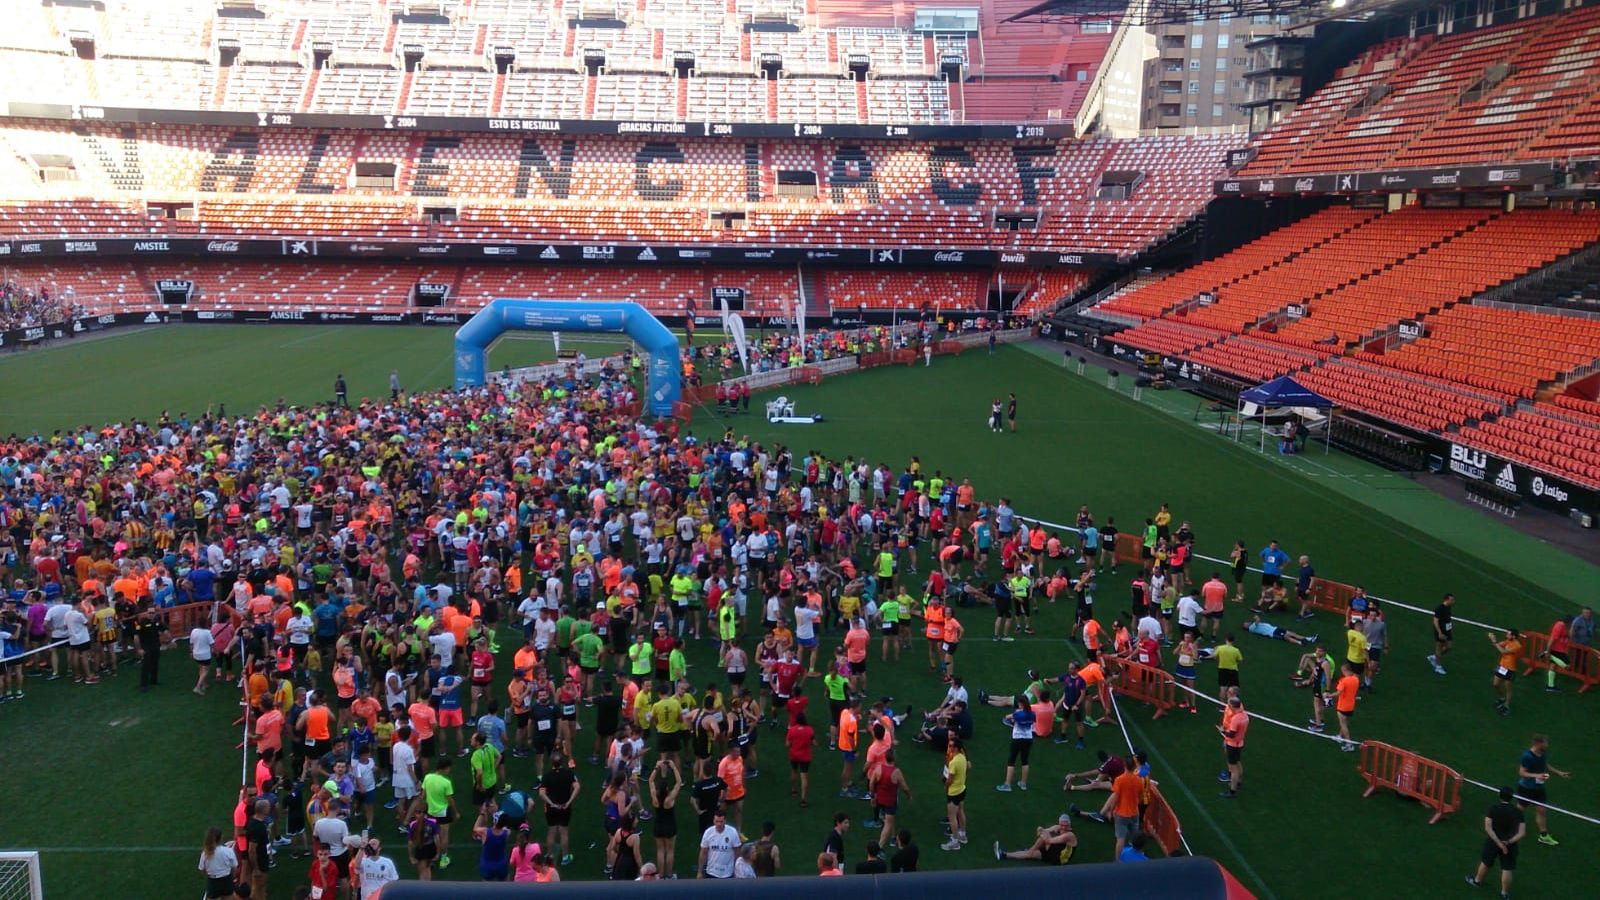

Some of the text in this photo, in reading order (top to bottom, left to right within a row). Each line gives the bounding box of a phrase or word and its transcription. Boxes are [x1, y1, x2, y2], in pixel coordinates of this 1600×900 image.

[489, 119, 560, 131] ESTO ES MESTALLA
[713, 124, 732, 134] 2004
[803, 125, 822, 135] 2004
[1025, 127, 1044, 136] 2019
[1223, 182, 1240, 192] AMSTEL
[134, 242, 170, 251] AMSTEL
[583, 246, 614, 254] BLU
[1001, 253, 1025, 263] bwin
[1059, 255, 1082, 264] AMSTEL
[1287, 305, 1303, 315] BLU
[270, 311, 304, 320] AMSTEL
[1399, 324, 1419, 336] BLU
[1495, 478, 1517, 492] adidas
[1544, 484, 1568, 502] LaLiga
